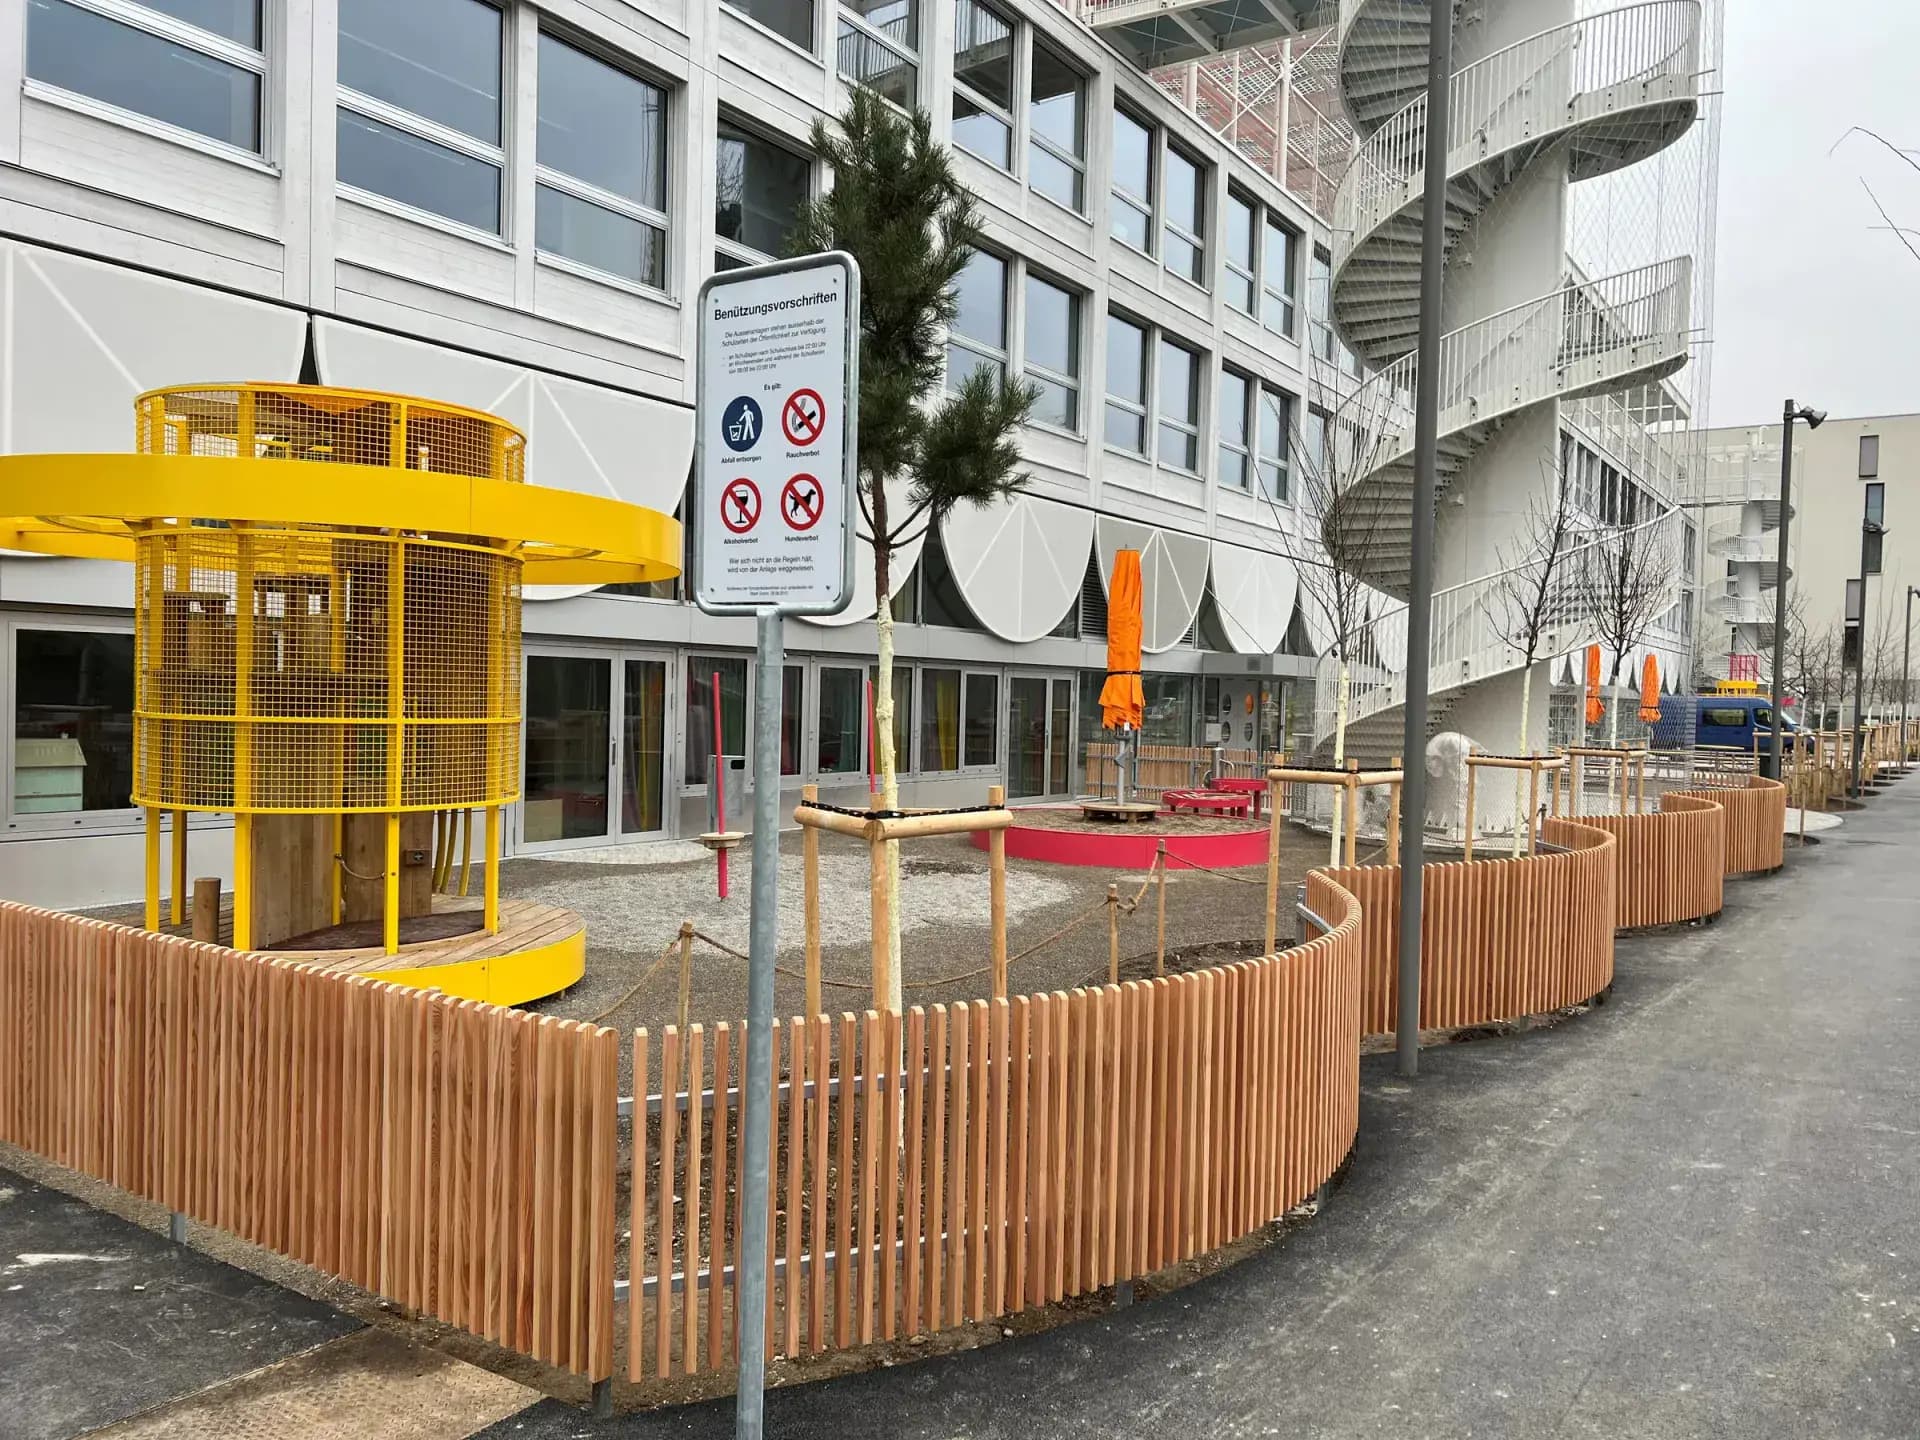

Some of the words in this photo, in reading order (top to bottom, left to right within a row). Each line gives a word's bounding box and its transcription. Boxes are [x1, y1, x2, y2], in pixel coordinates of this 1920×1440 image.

[714, 292, 837, 320] Benützungsvorschriften
[786, 450, 820, 458] Rauchverbot
[782, 556, 800, 564] Regeln
